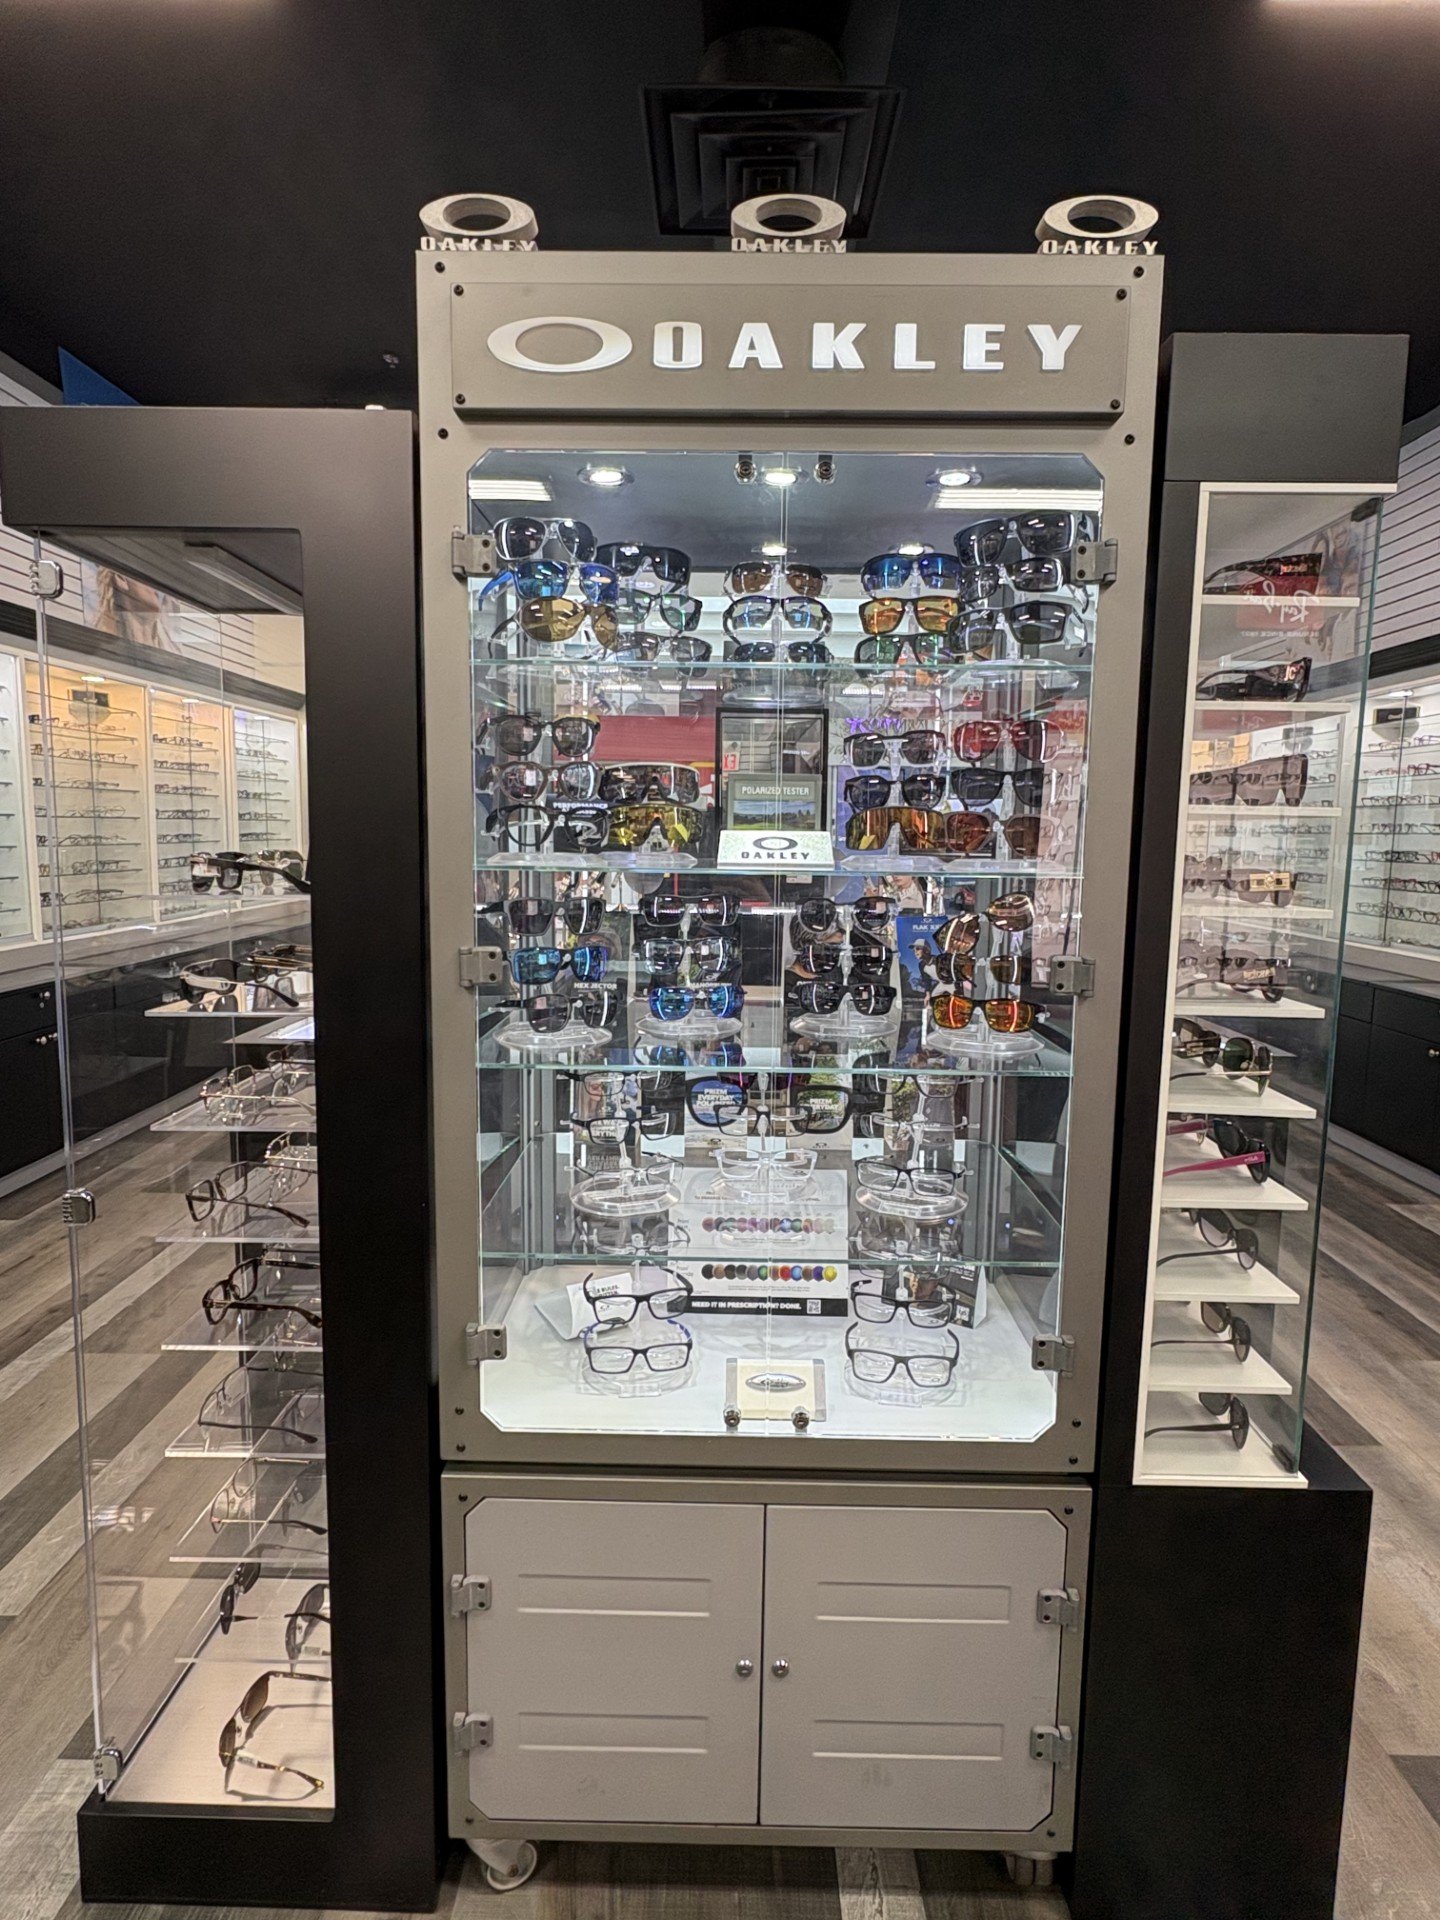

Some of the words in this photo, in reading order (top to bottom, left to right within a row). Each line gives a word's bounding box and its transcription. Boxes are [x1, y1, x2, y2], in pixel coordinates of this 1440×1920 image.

[420, 236, 538, 252] OAKLEY
[731, 237, 847, 254] OAKLEY
[1042, 239, 1159, 256] OAKLEY
[653, 321, 1083, 371] OAKLEY
[742, 786, 781, 795] POLARIZED
[783, 787, 810, 796] TESTER
[741, 851, 810, 860] OAKLEY
